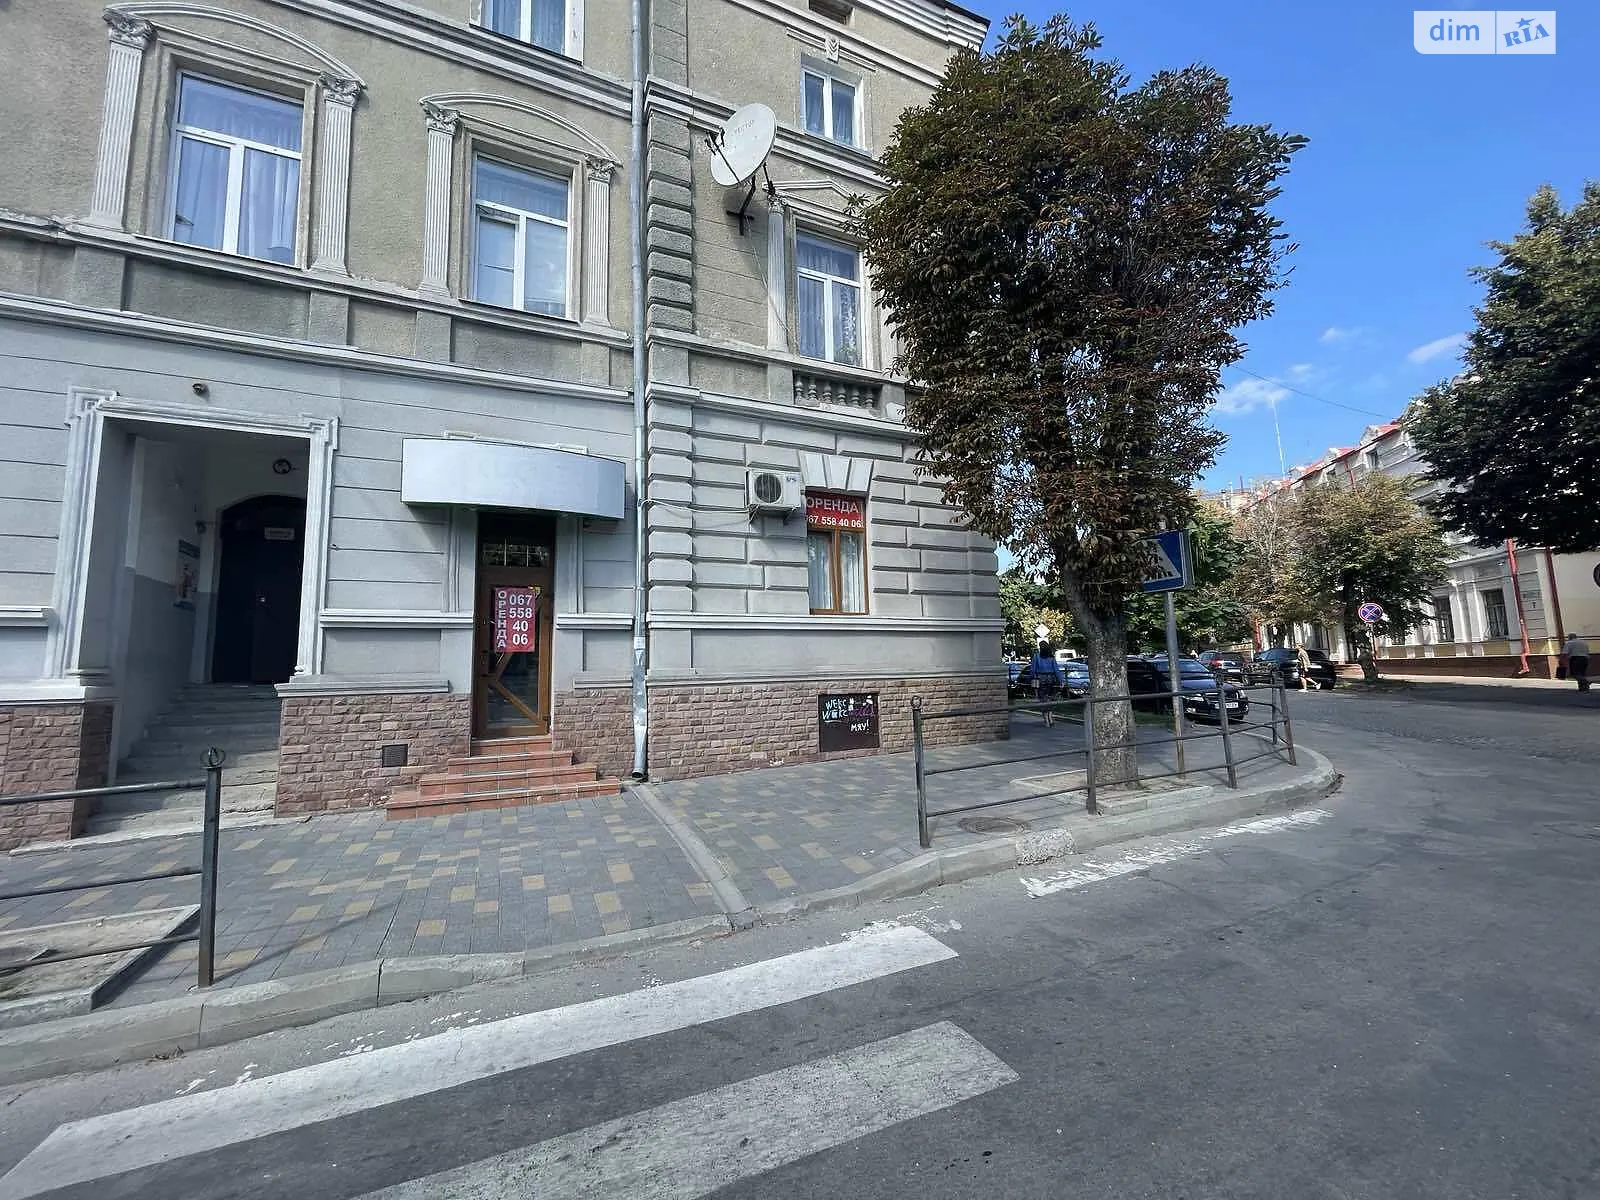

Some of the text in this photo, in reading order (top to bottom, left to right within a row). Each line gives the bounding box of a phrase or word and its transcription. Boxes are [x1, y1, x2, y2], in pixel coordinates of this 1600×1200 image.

[806, 496, 859, 514] ОРЕНДА
[807, 514, 862, 528] 67 558 40 06
[509, 594, 533, 606] 067
[496, 590, 507, 648] ОРЕНДА
[509, 607, 533, 619] 558
[512, 620, 529, 632] 40
[512, 633, 529, 645] 06
